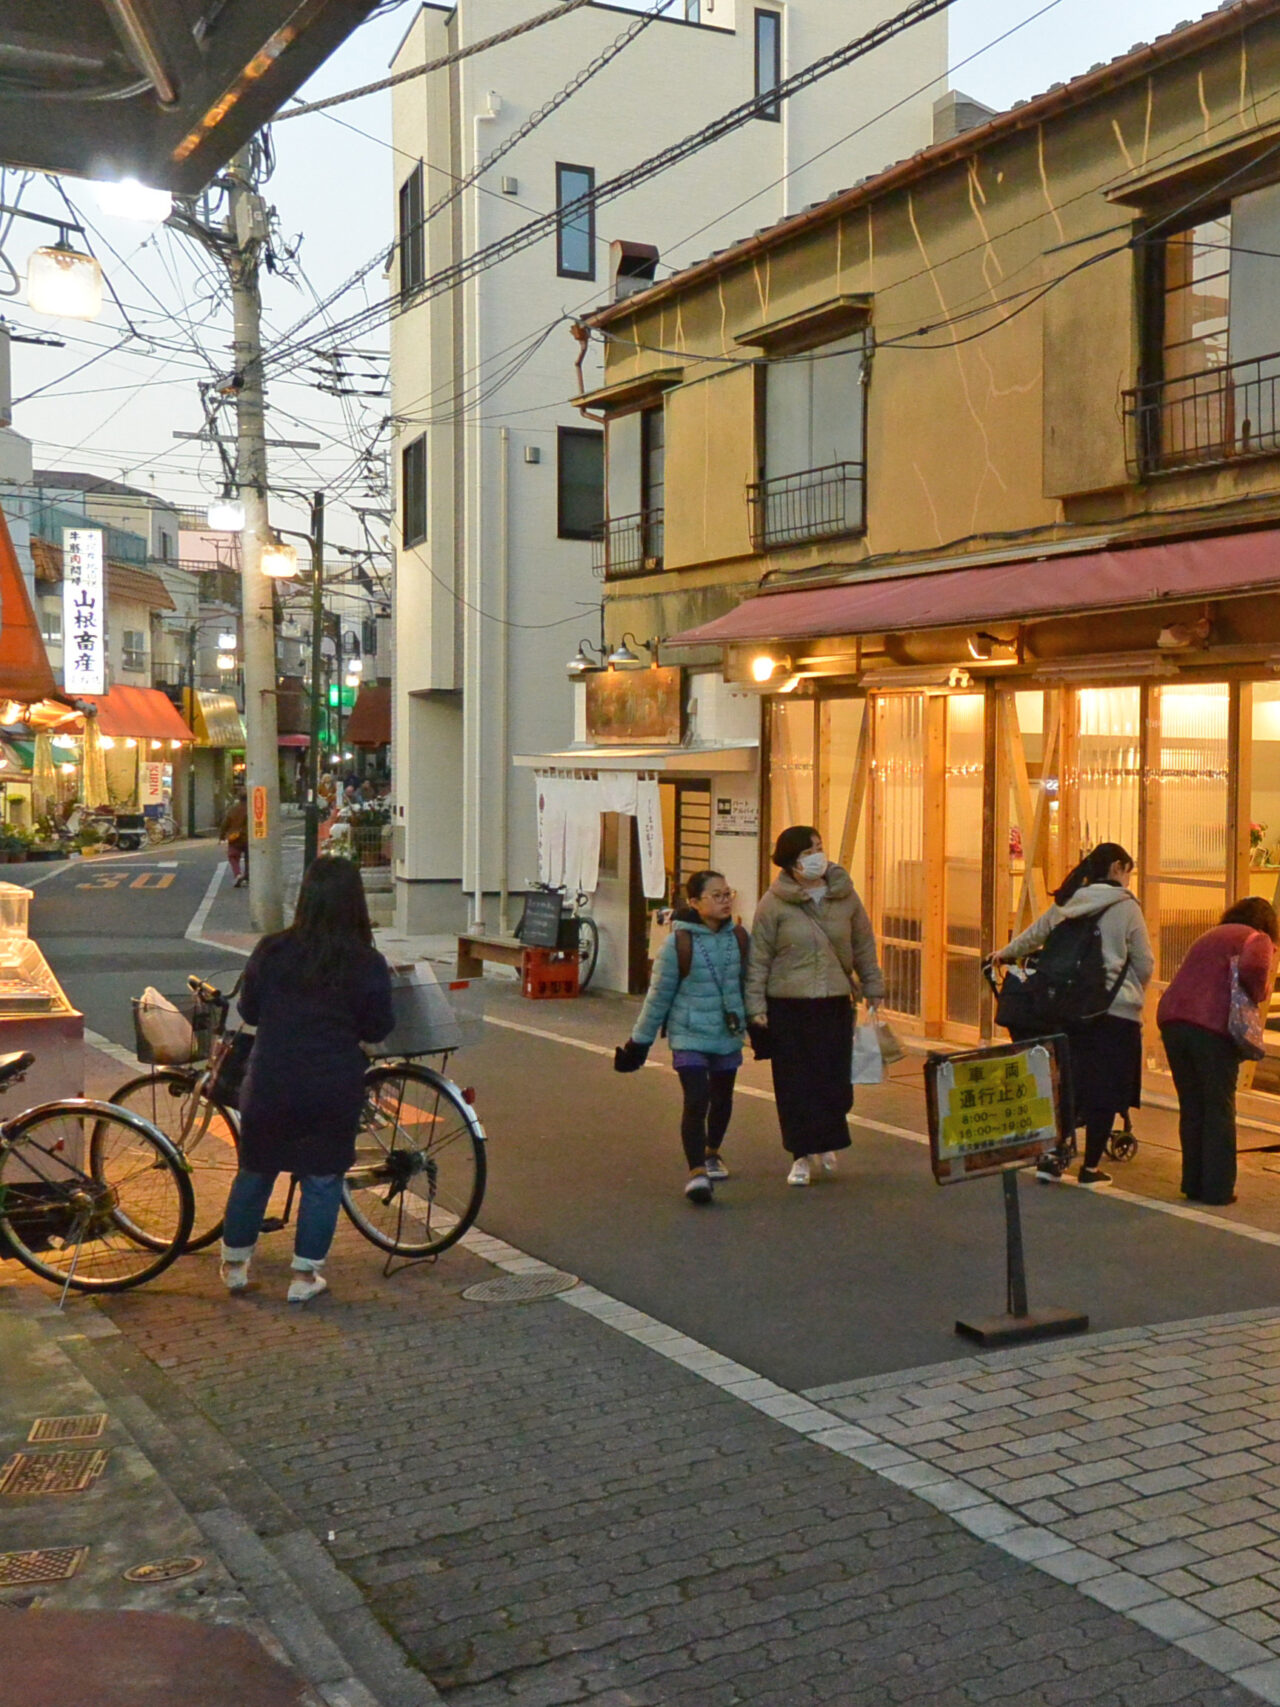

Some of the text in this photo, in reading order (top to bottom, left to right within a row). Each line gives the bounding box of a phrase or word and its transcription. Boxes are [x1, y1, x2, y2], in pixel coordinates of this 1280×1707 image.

[74, 589, 98, 672] 山根畜産
[149, 765, 159, 796] KIRIN
[75, 873, 177, 889] 30
[960, 1083, 1028, 1109] 通行止め
